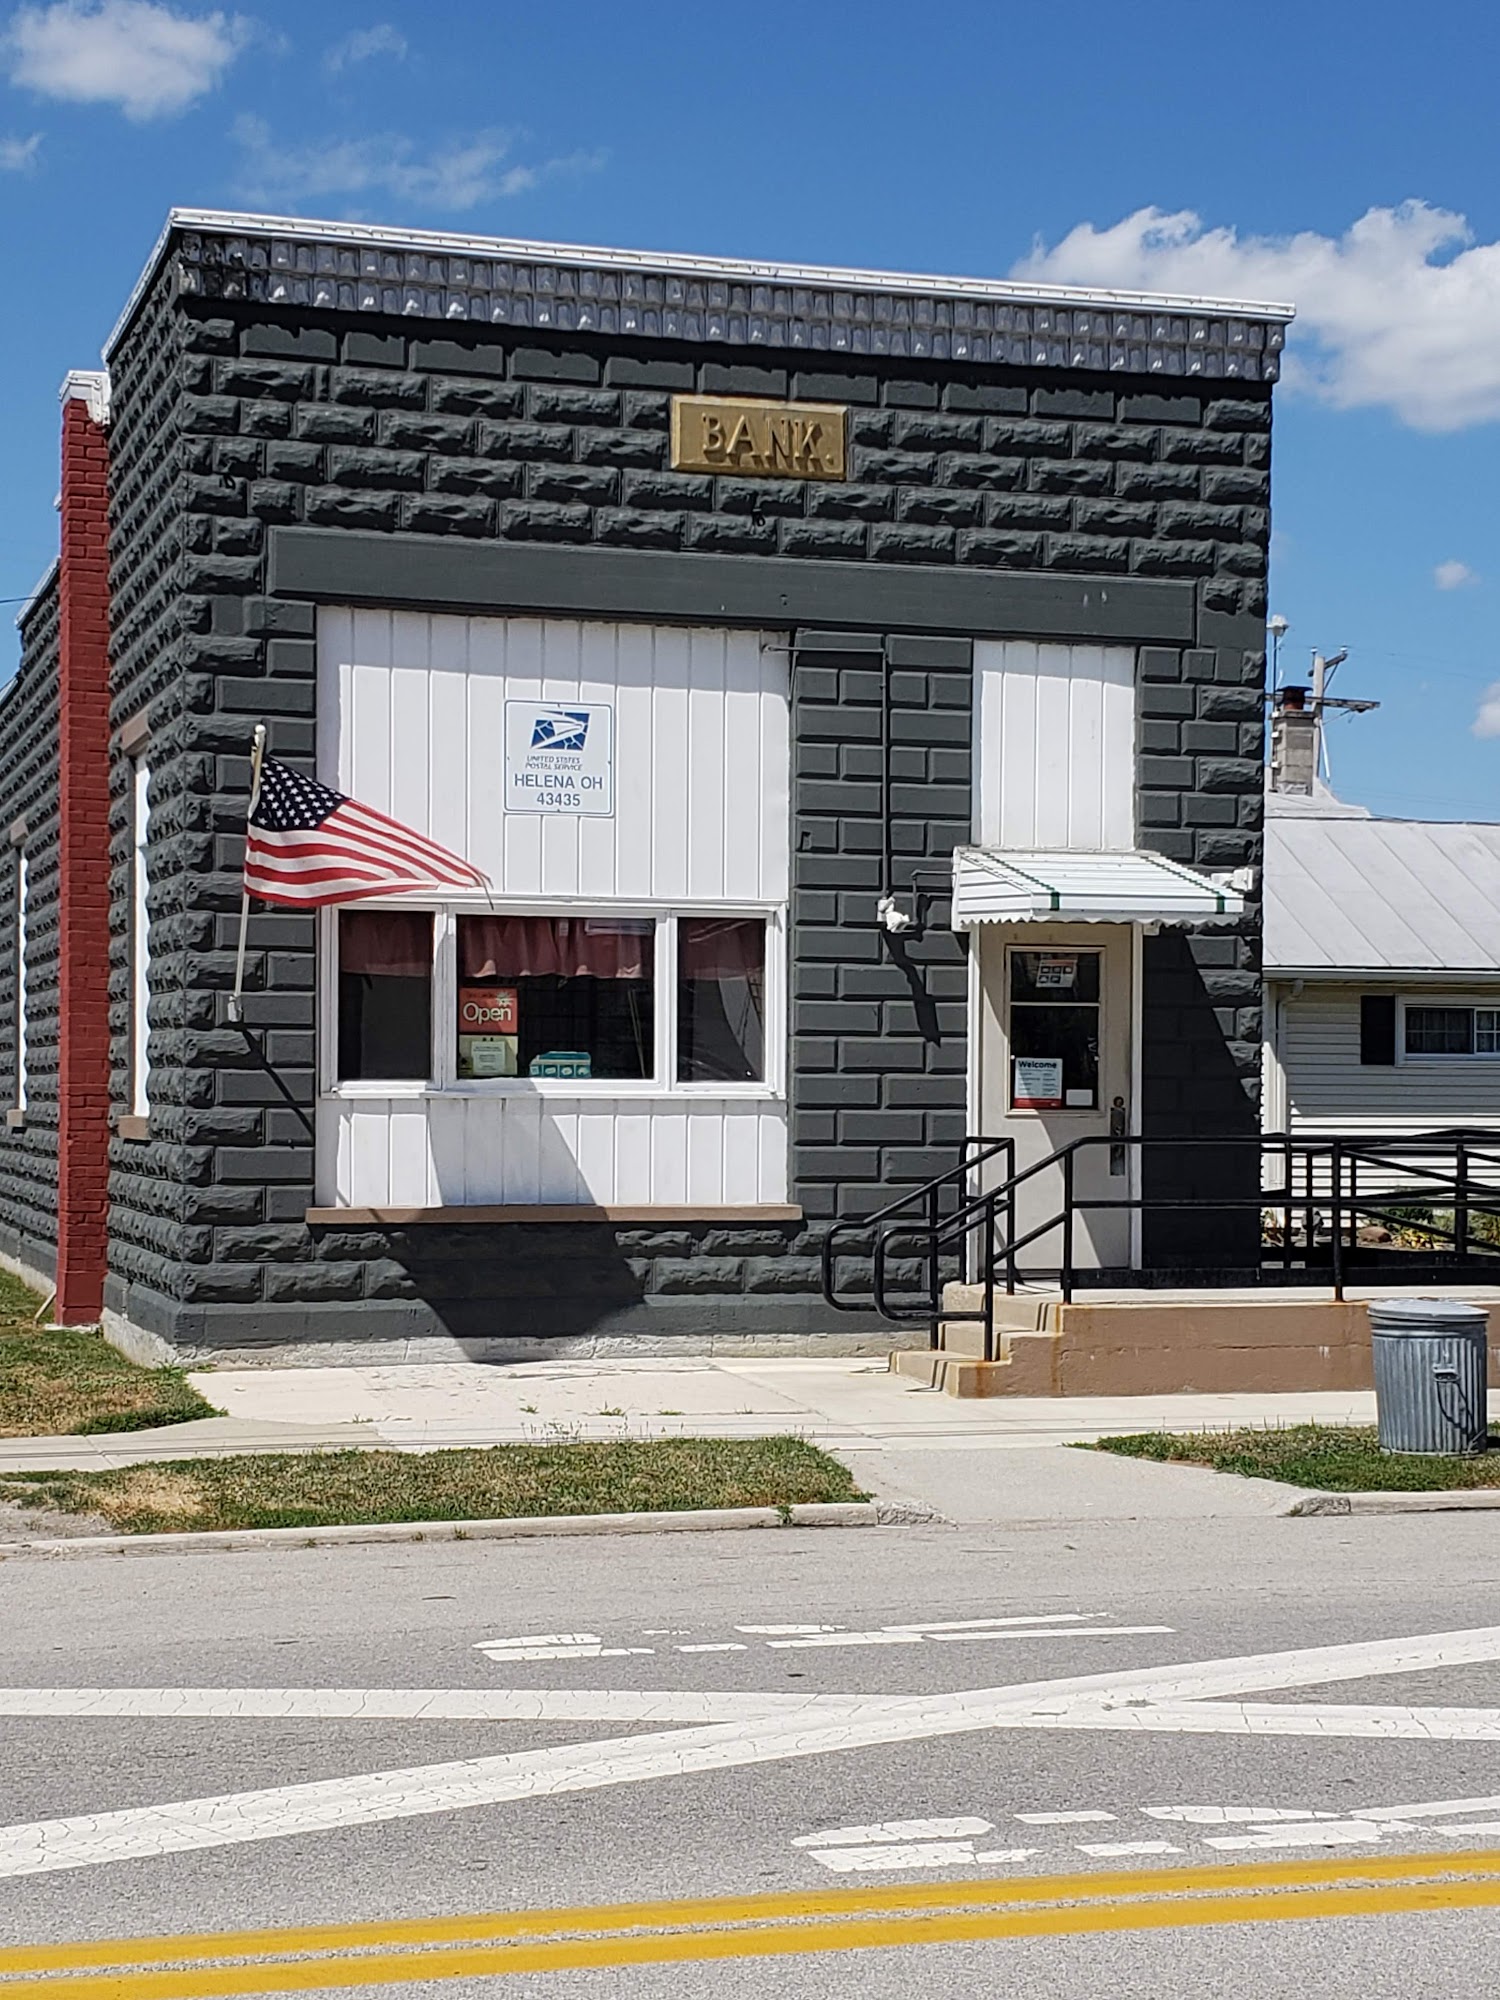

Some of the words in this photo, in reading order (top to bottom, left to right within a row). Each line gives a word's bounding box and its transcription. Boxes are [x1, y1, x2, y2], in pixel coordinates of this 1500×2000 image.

[526, 755, 555, 763] UNITED
[525, 762, 552, 770] POSTAL
[554, 763, 582, 771] SERVICE
[514, 773, 576, 789] HELENA
[580, 776, 603, 790] OH
[537, 792, 581, 806] 43435
[463, 1003, 512, 1025] Open
[1018, 1061, 1057, 1069] Welcome
